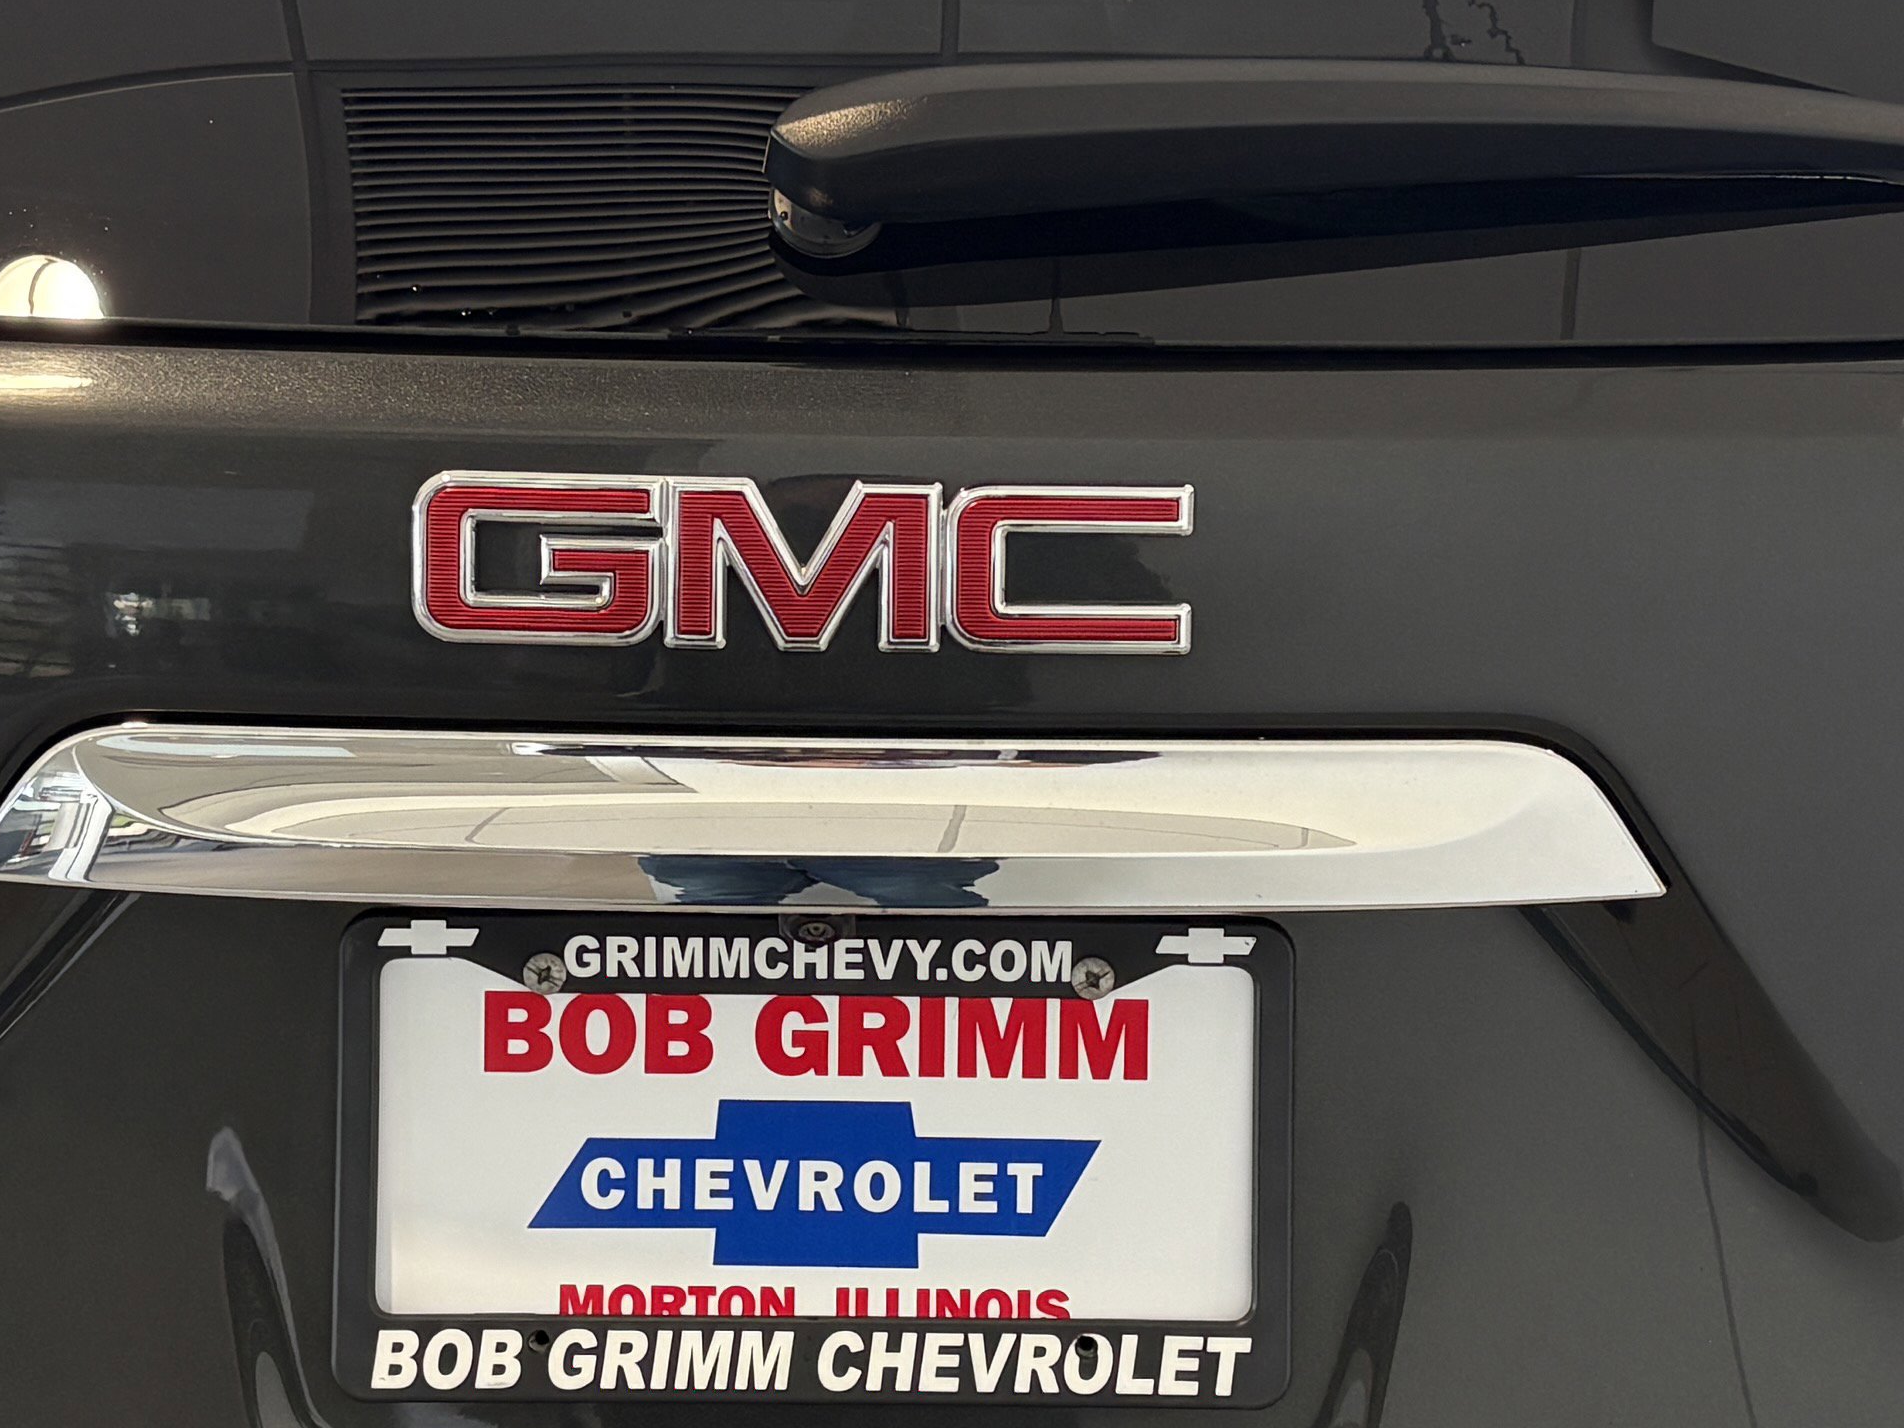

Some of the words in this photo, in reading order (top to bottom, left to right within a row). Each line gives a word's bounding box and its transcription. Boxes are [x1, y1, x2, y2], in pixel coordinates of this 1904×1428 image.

[411, 470, 1194, 654] GMC
[562, 933, 1072, 983] GRIMMCHEVY.COM
[483, 990, 714, 1075] BOB
[754, 993, 1150, 1081] GRIMM
[580, 1156, 1044, 1214] CHEVROLET
[370, 1328, 524, 1391] BOB
[547, 1328, 795, 1391] GRIMM
[817, 1330, 1253, 1397] CHEVROLET
